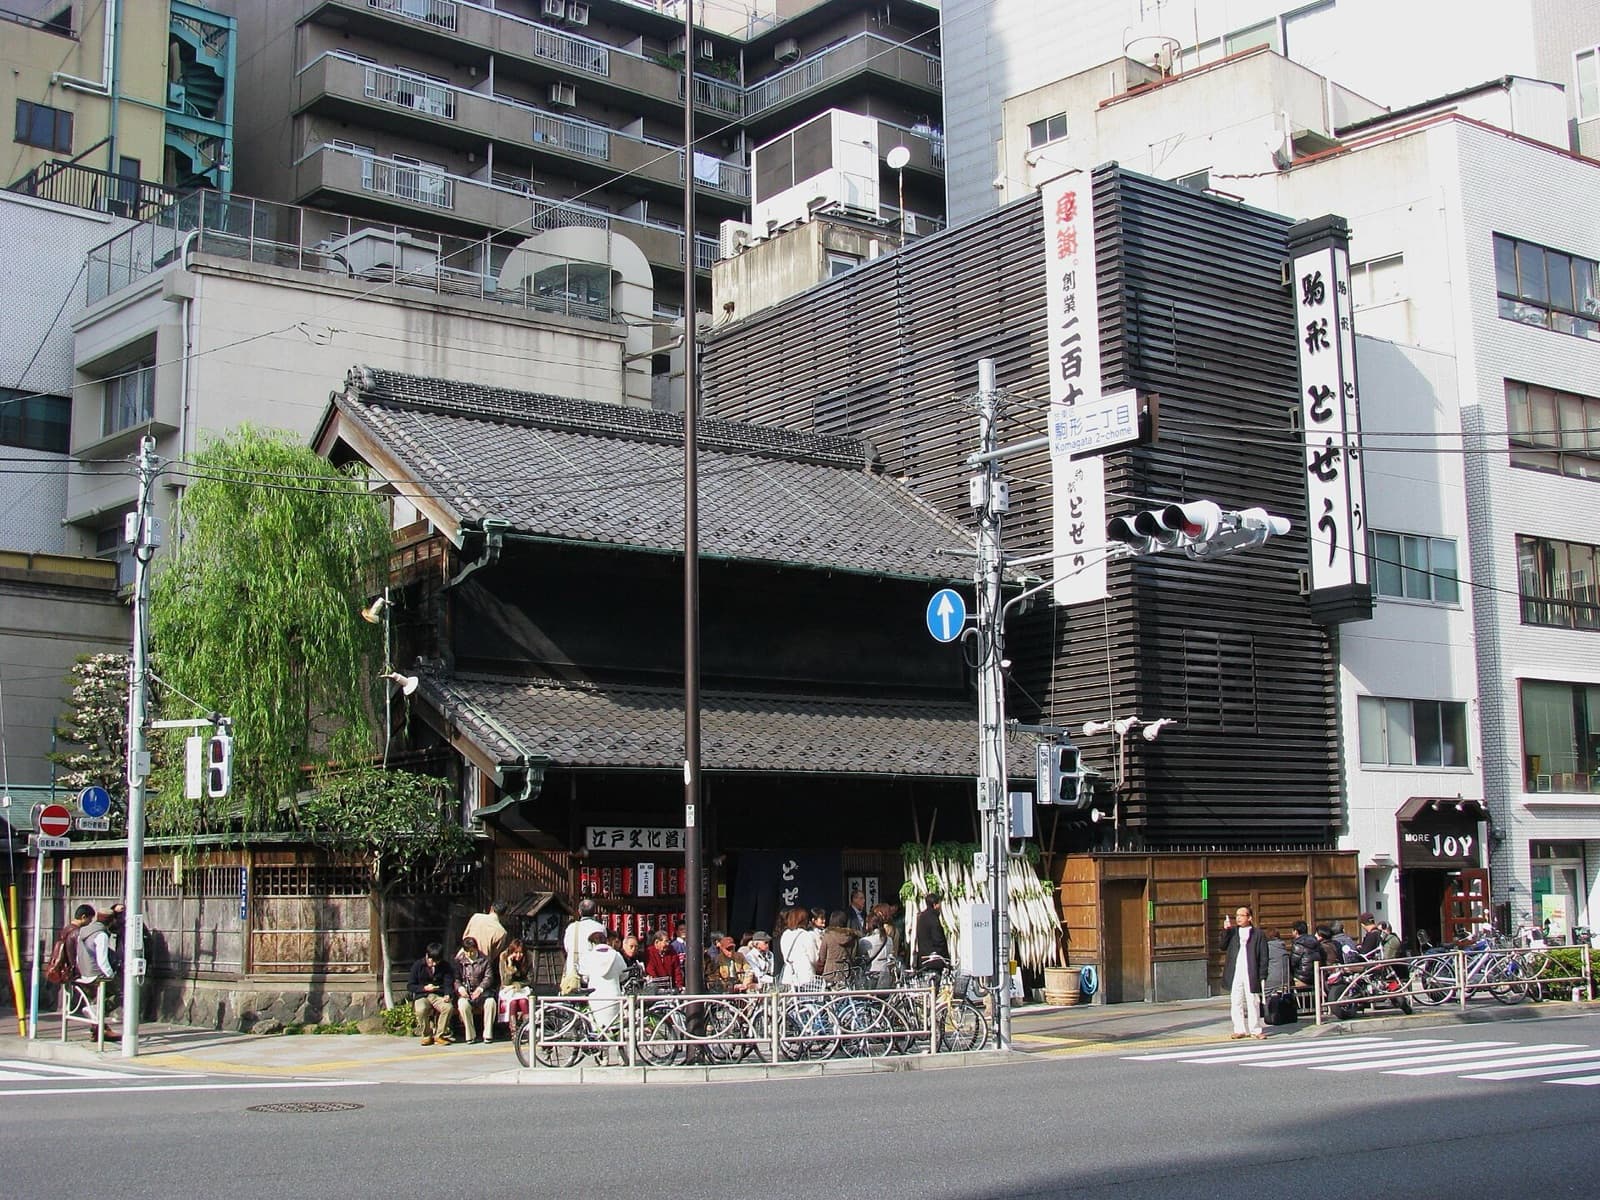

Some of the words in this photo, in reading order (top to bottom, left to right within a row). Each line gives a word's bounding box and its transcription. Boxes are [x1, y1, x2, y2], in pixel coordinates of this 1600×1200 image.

[1055, 405, 1129, 440] 駒形二丁目
[1302, 270, 1341, 567] 駒形どぜう
[1055, 436, 1092, 453] Komagata
[1096, 426, 1132, 442] 2-chome
[592, 829, 685, 848] 江戸文化道
[1405, 833, 1430, 842] MORE
[1432, 834, 1472, 857] JOY
